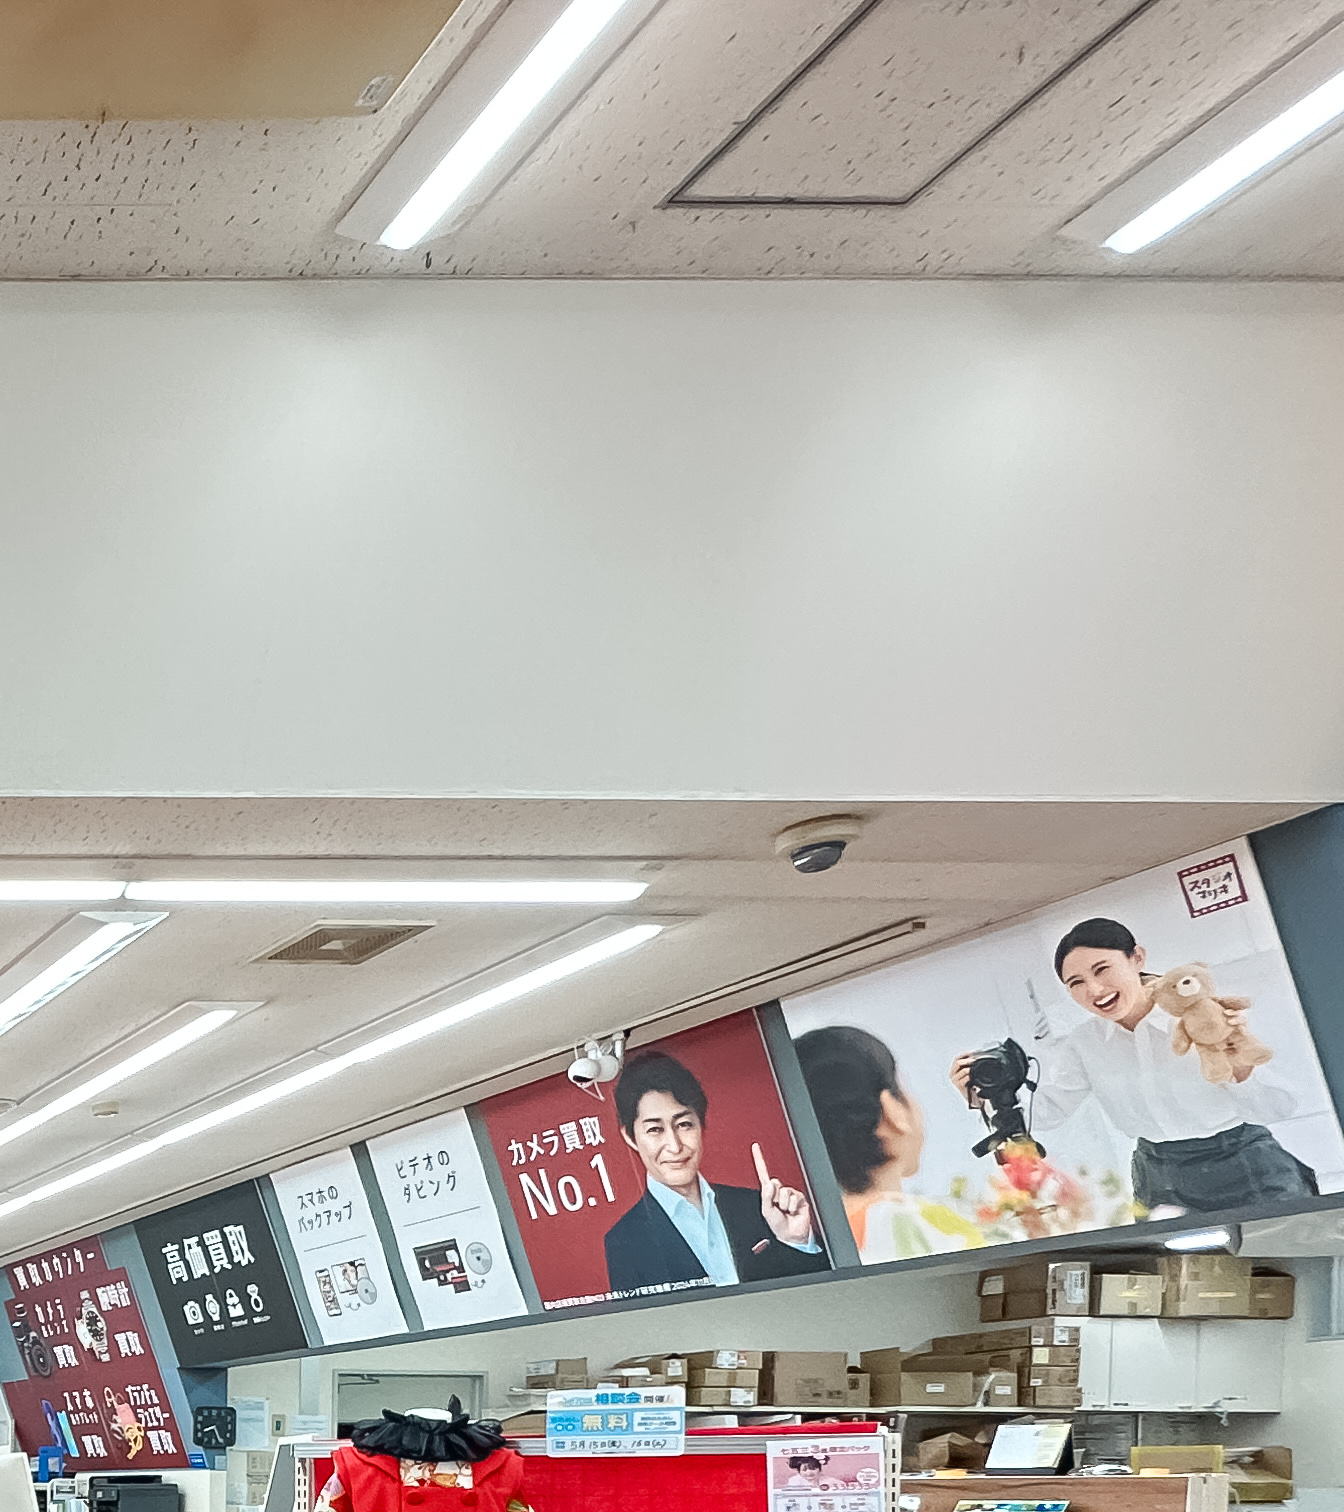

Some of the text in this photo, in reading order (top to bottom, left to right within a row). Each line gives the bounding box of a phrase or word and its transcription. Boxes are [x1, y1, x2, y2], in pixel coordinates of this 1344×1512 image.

[507, 1115, 606, 1166] カメラ買取
[395, 1151, 450, 1179] ビデオの
[297, 1186, 339, 1211] スマホの
[403, 1170, 457, 1203] ダビング
[518, 1153, 616, 1220] No.1
[297, 1200, 353, 1233] バックアップ
[161, 1225, 256, 1285] 高価買取
[53, 1345, 80, 1369] 買取
[114, 1331, 145, 1358] 買取
[81, 1434, 108, 1458] 買取
[146, 1429, 178, 1455] 買取
